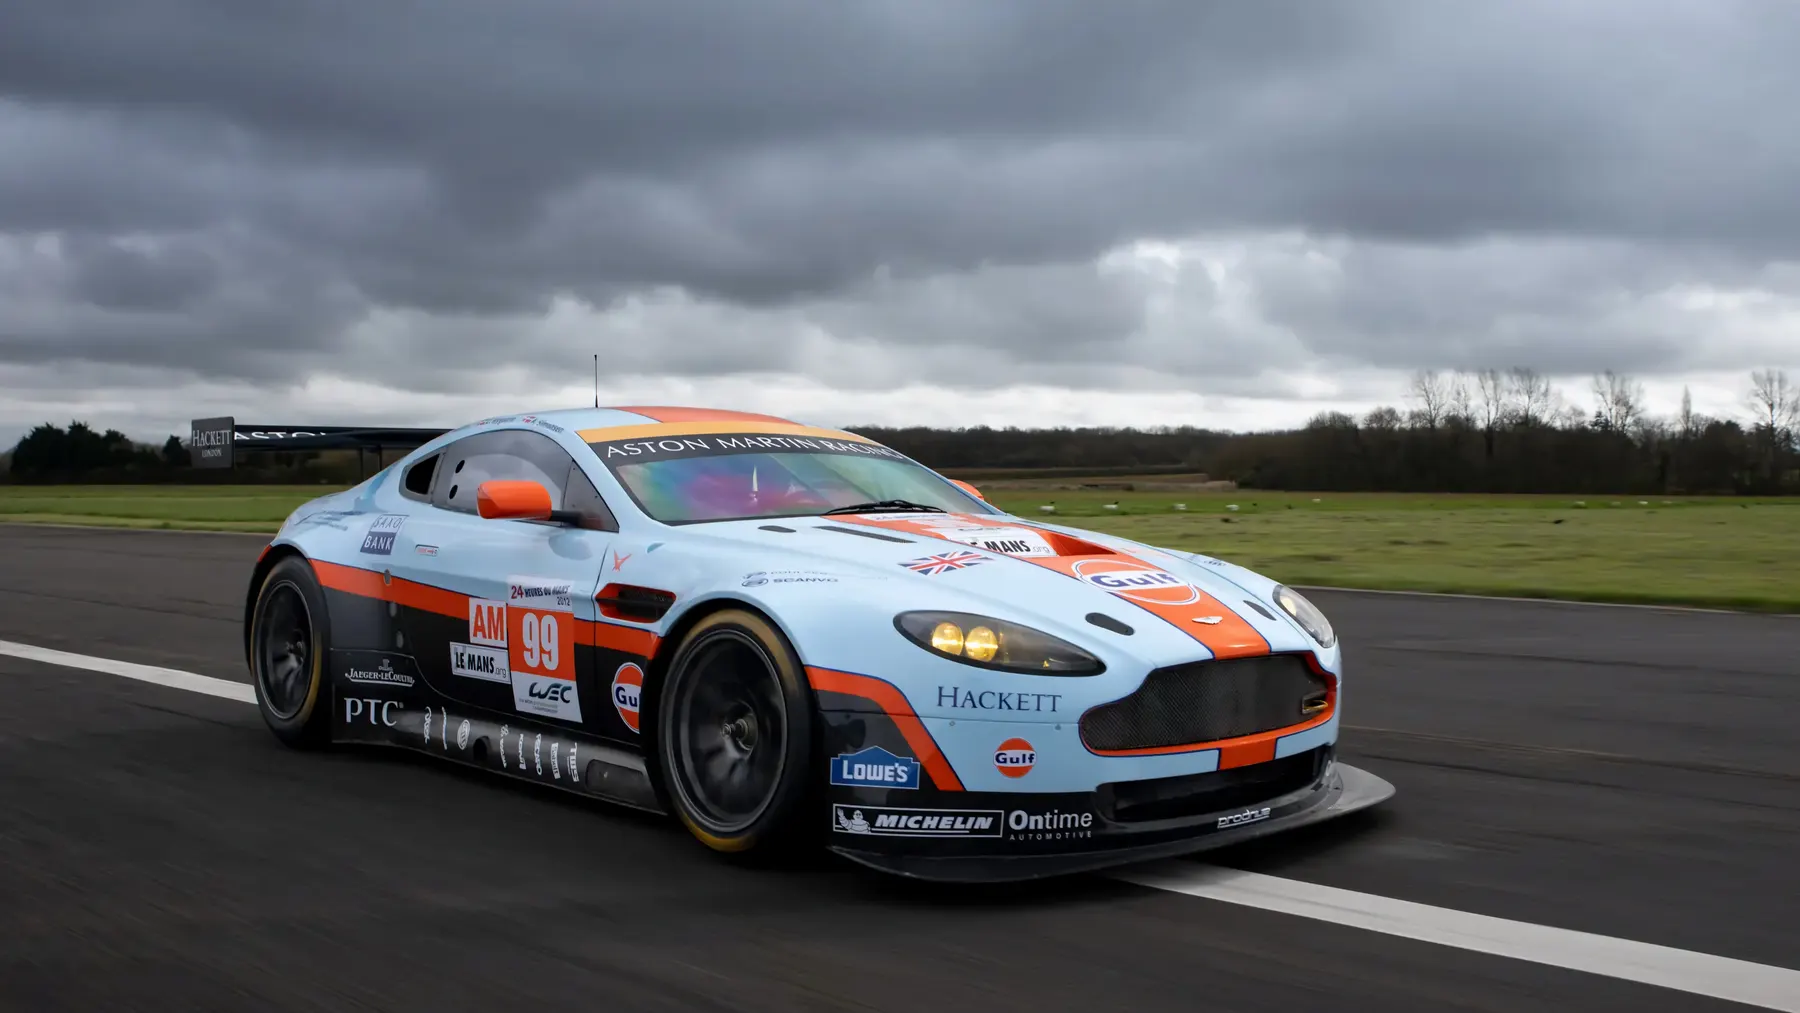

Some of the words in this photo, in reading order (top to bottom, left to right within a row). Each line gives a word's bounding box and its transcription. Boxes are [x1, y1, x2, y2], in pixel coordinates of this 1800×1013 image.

[192, 429, 232, 447] HACKETT
[201, 449, 222, 458] LONDON
[607, 438, 711, 458] ASTON
[716, 436, 820, 450] MARTIN
[373, 516, 402, 529] SAXO
[364, 535, 393, 551] BANK
[1090, 571, 1181, 588] Gulf
[511, 585, 524, 599] 24
[557, 596, 570, 606] 2012
[473, 604, 505, 641] AM
[522, 612, 559, 671] 99
[455, 651, 465, 669] LE
[528, 682, 573, 703] WEC
[936, 686, 1062, 712] HACKETT
[995, 752, 1035, 765] Gulf
[842, 760, 909, 783] LOWE'S
[874, 813, 994, 830] MICHELIN
[1008, 809, 1093, 832] Ontime
[1009, 830, 1092, 841] AUTOMOTIVE
